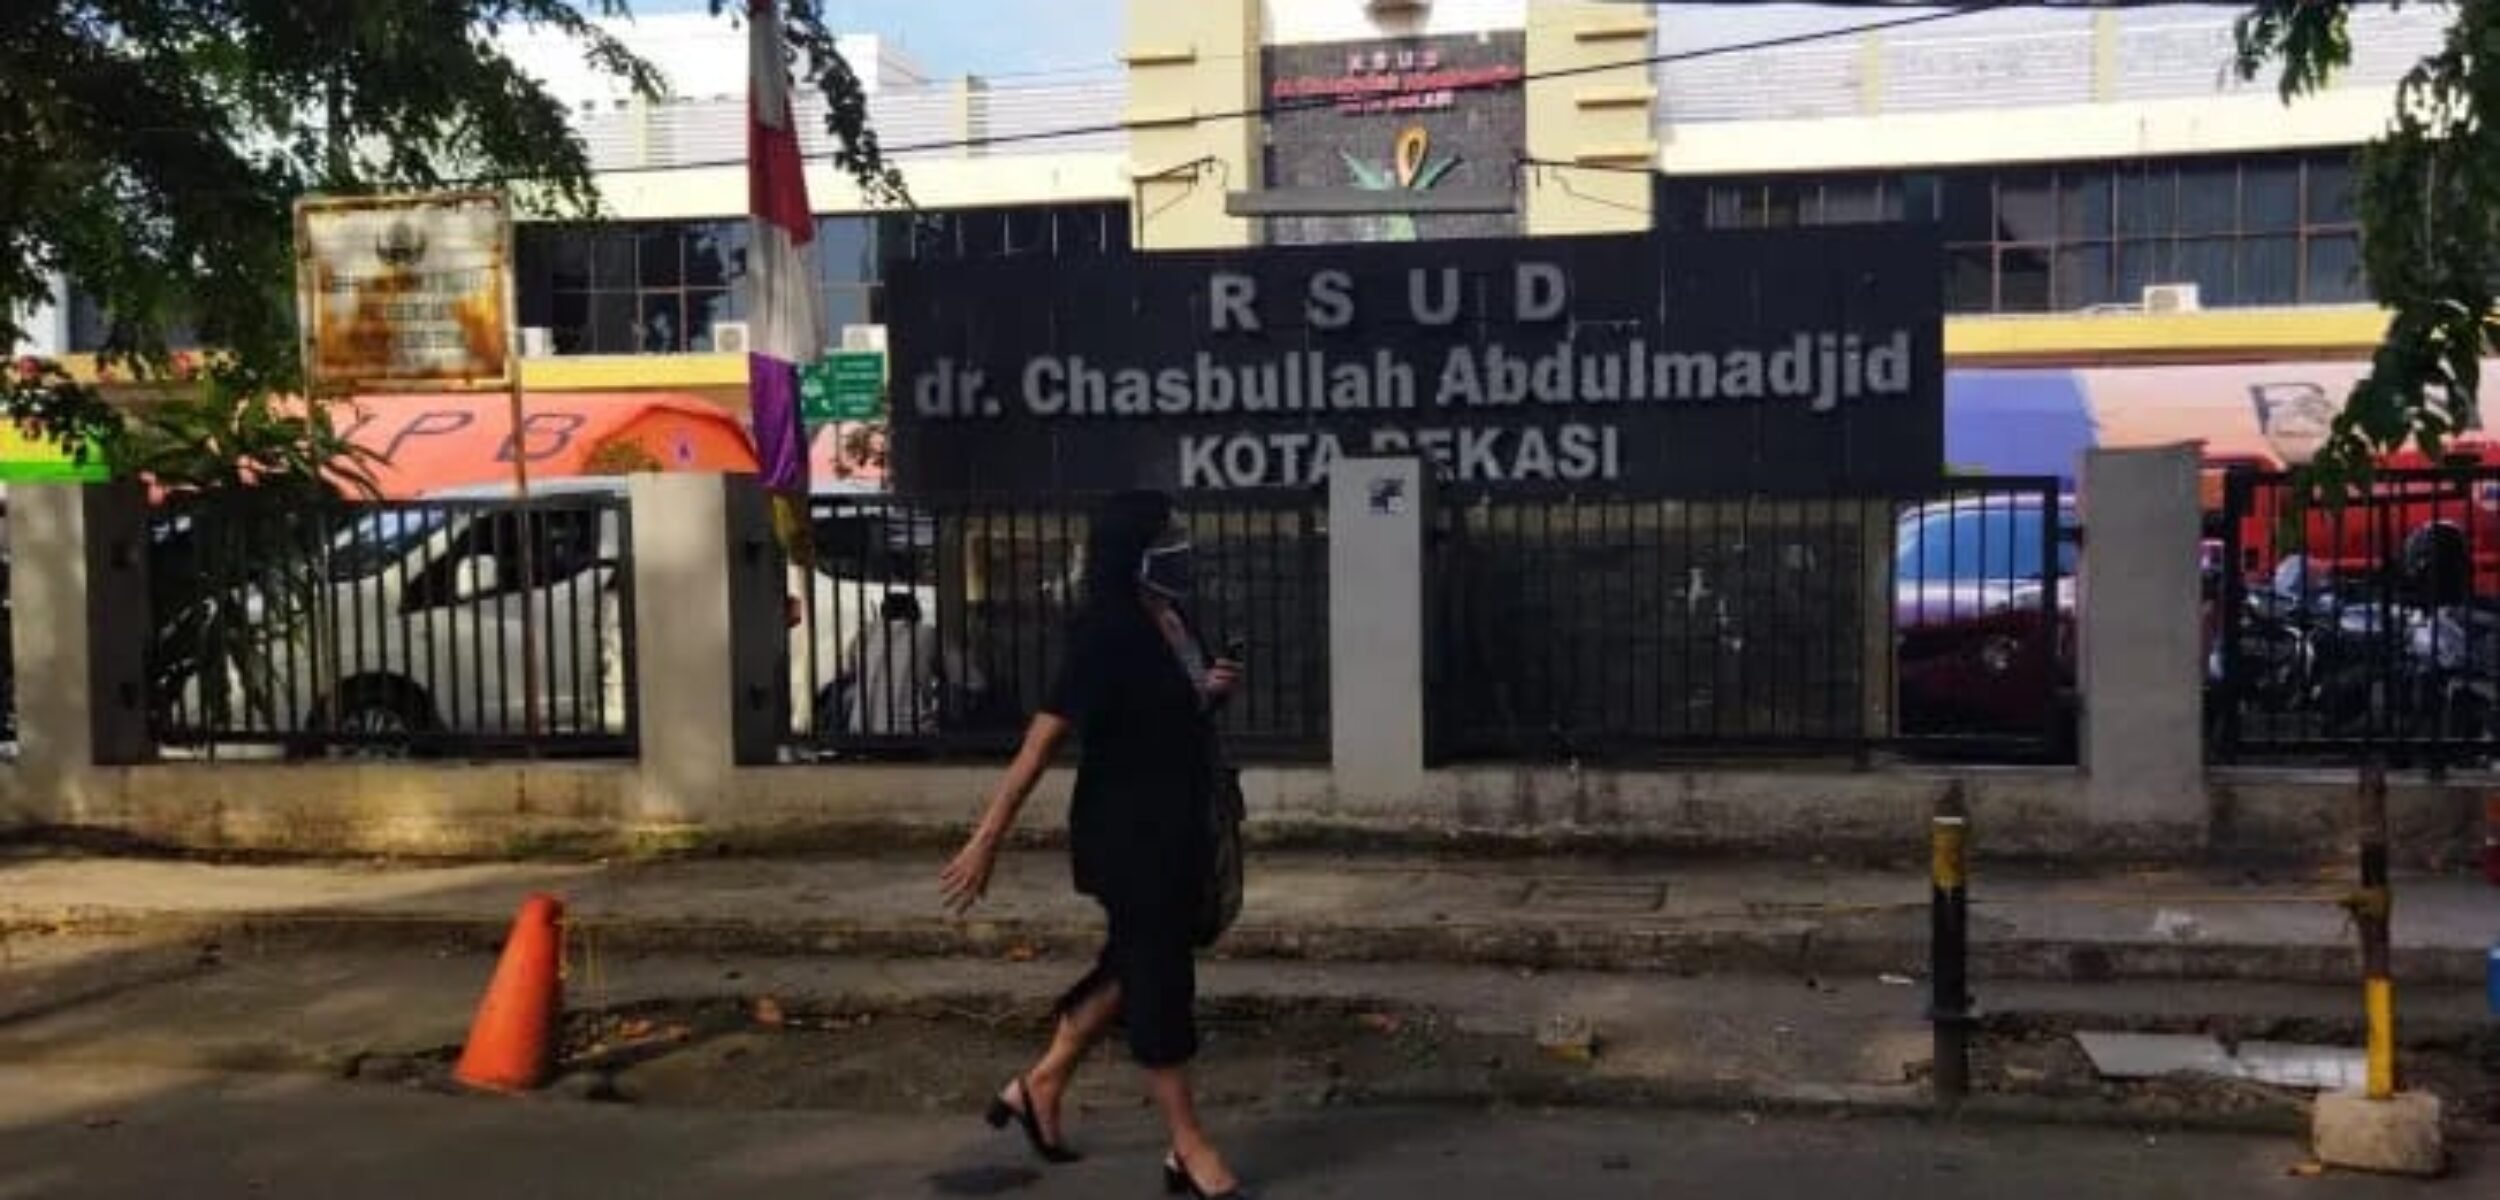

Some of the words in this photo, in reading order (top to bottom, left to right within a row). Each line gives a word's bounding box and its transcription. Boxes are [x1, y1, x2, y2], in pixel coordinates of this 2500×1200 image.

[914, 357, 1000, 416] dr.
[1021, 348, 1416, 414] Chasbullah
[1435, 331, 1911, 410] Abdulmadjid
[1179, 431, 1344, 488] KOTA
